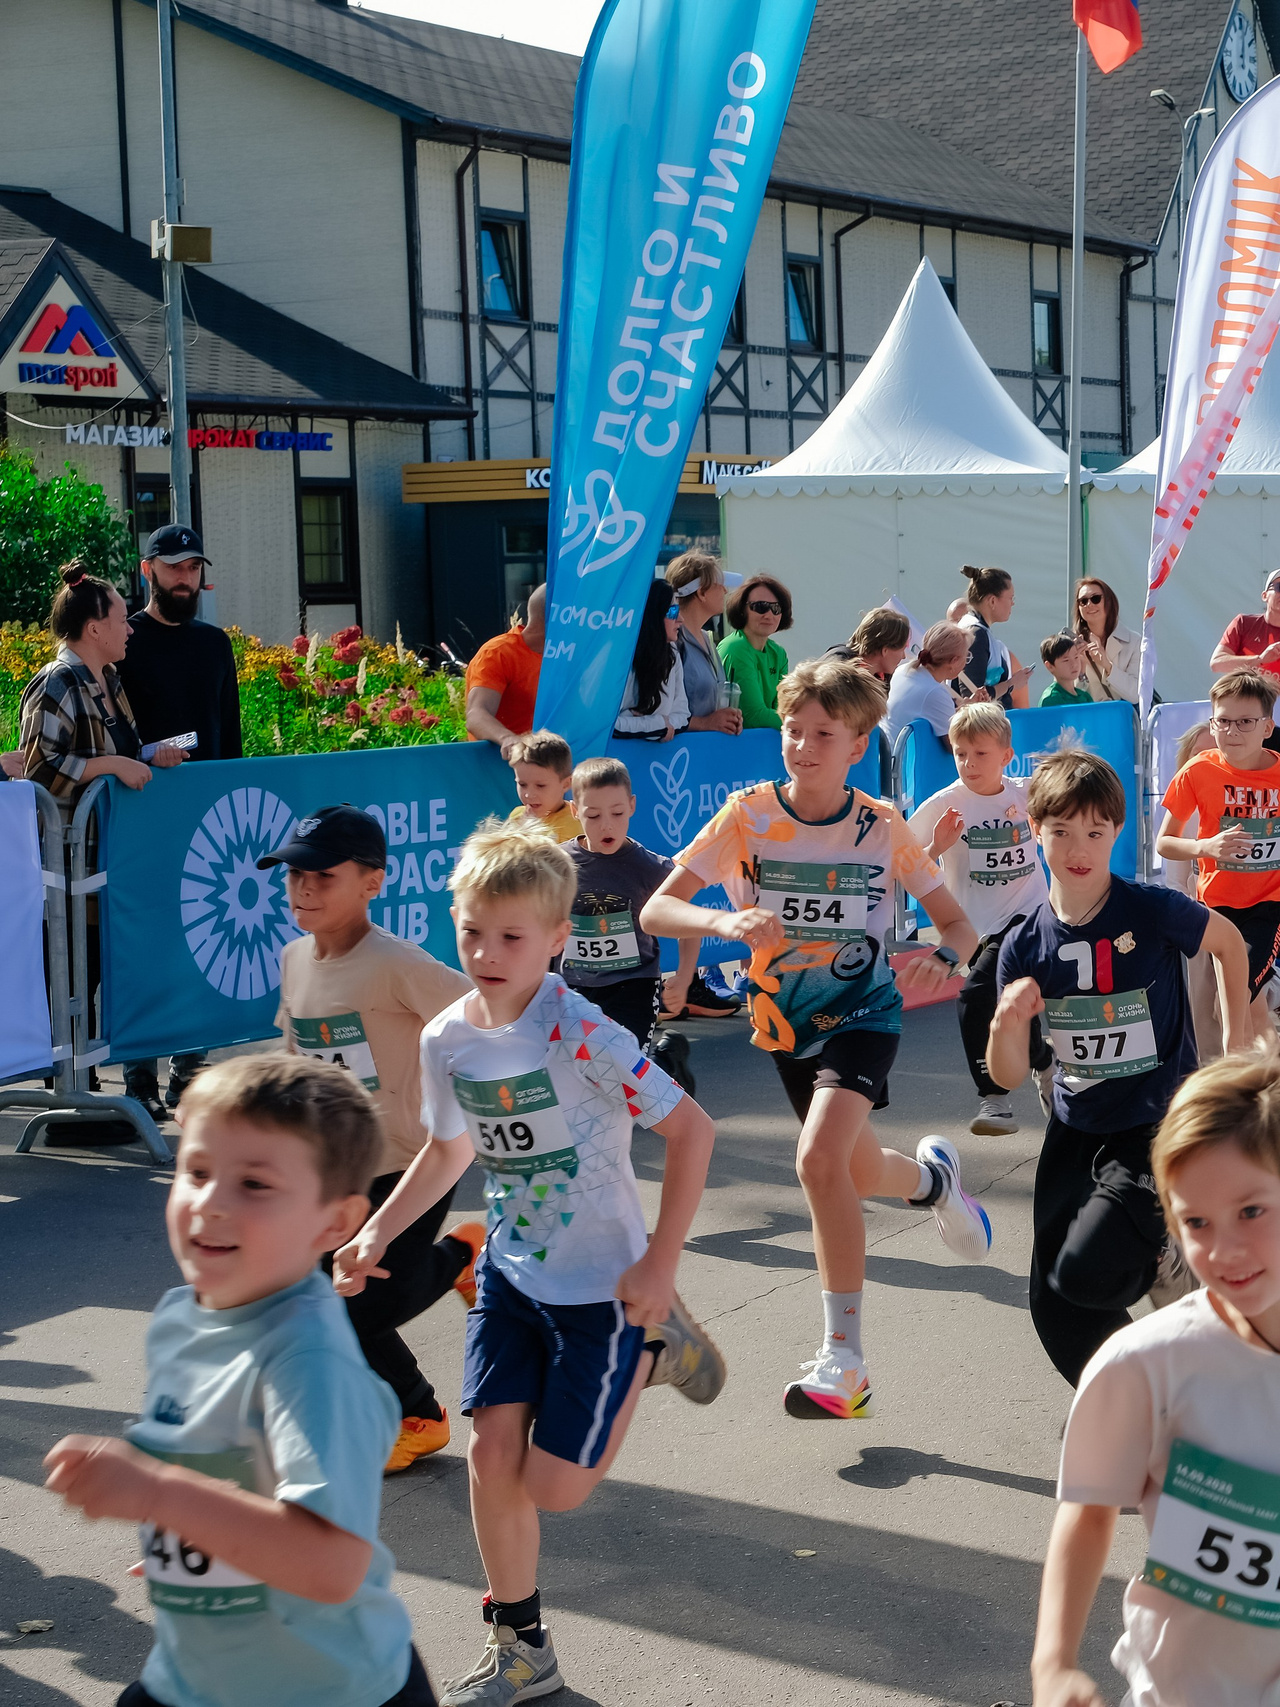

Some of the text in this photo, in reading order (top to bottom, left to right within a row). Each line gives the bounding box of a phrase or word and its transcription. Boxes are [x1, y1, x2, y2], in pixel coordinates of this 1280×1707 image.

[634, 51, 766, 458] СЧАСТЛИВО
[593, 163, 696, 455] ДОЛГО И
[18, 362, 118, 391] marsport
[256, 431, 333, 451] СЕРВИС
[1223, 784, 1279, 808] DEMIX
[1223, 806, 1279, 819] ACTIVE
[986, 848, 1026, 869] 543
[782, 898, 844, 923] 554
[577, 939, 620, 958] 552
[1117, 1007, 1146, 1019] ЖИЗНИ
[1118, 1002, 1143, 1012] ОГОНЬ
[1072, 1031, 1127, 1060] 577
[515, 1086, 547, 1098] ОГОНЬ
[516, 1091, 552, 1106] ЖИЗНИ
[478, 1121, 534, 1152] 519
